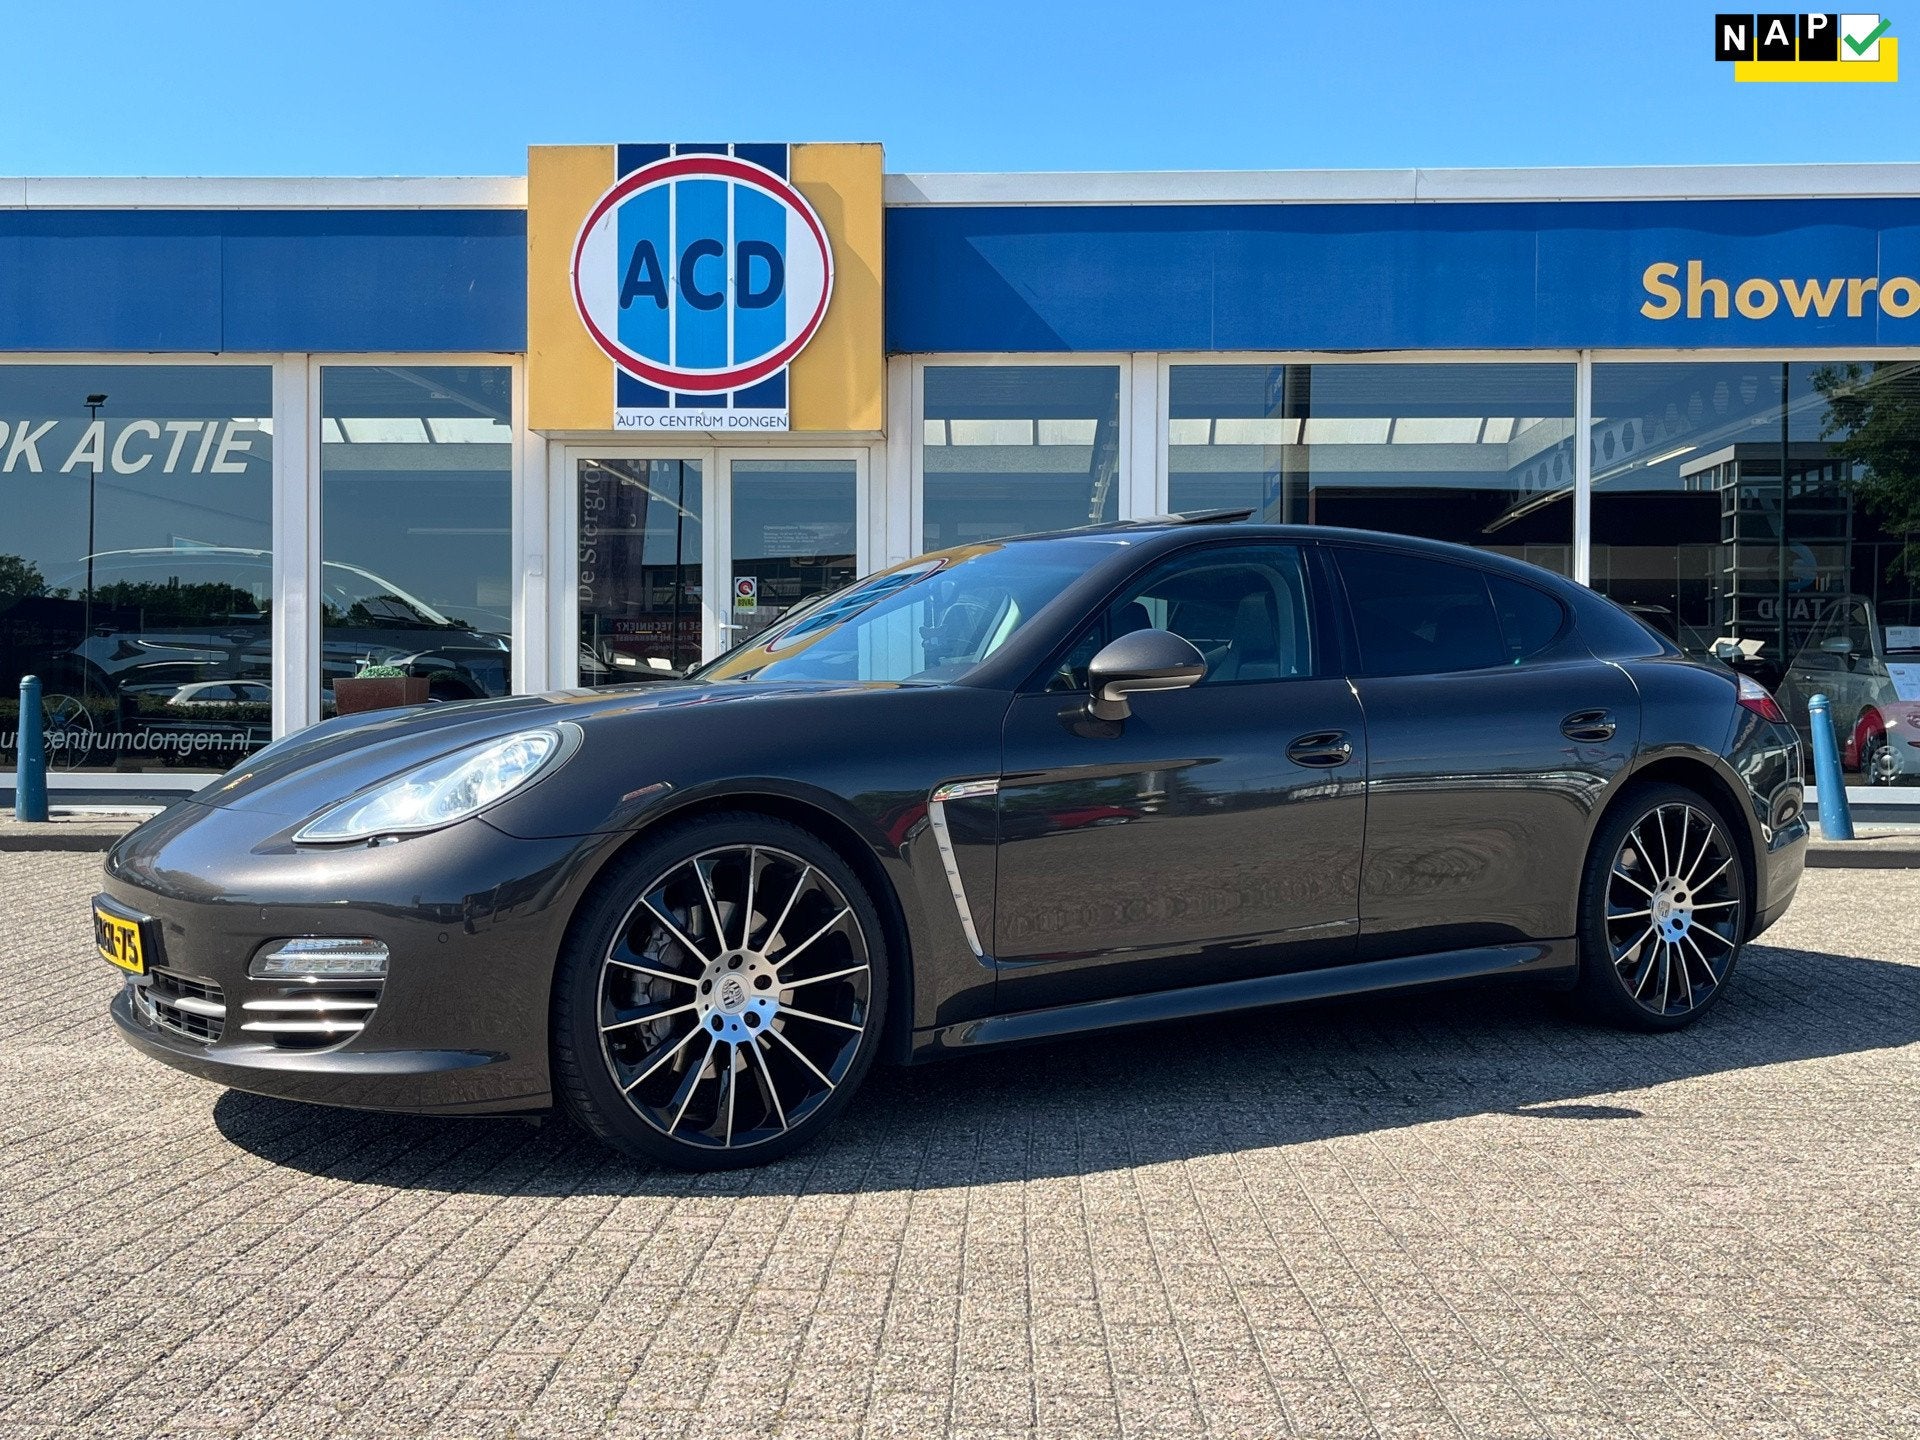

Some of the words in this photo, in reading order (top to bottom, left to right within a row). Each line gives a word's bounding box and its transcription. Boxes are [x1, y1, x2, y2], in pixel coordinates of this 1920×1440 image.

[619, 238, 785, 311] ACD
[1640, 260, 1920, 319] Showro
[0, 420, 59, 472] K
[60, 420, 262, 473] ACTIE
[617, 415, 655, 427] AUTO
[659, 416, 723, 427] CENTRUM
[728, 416, 787, 428] DONGEN
[1, 728, 252, 756] ucentrumdongen.nl
